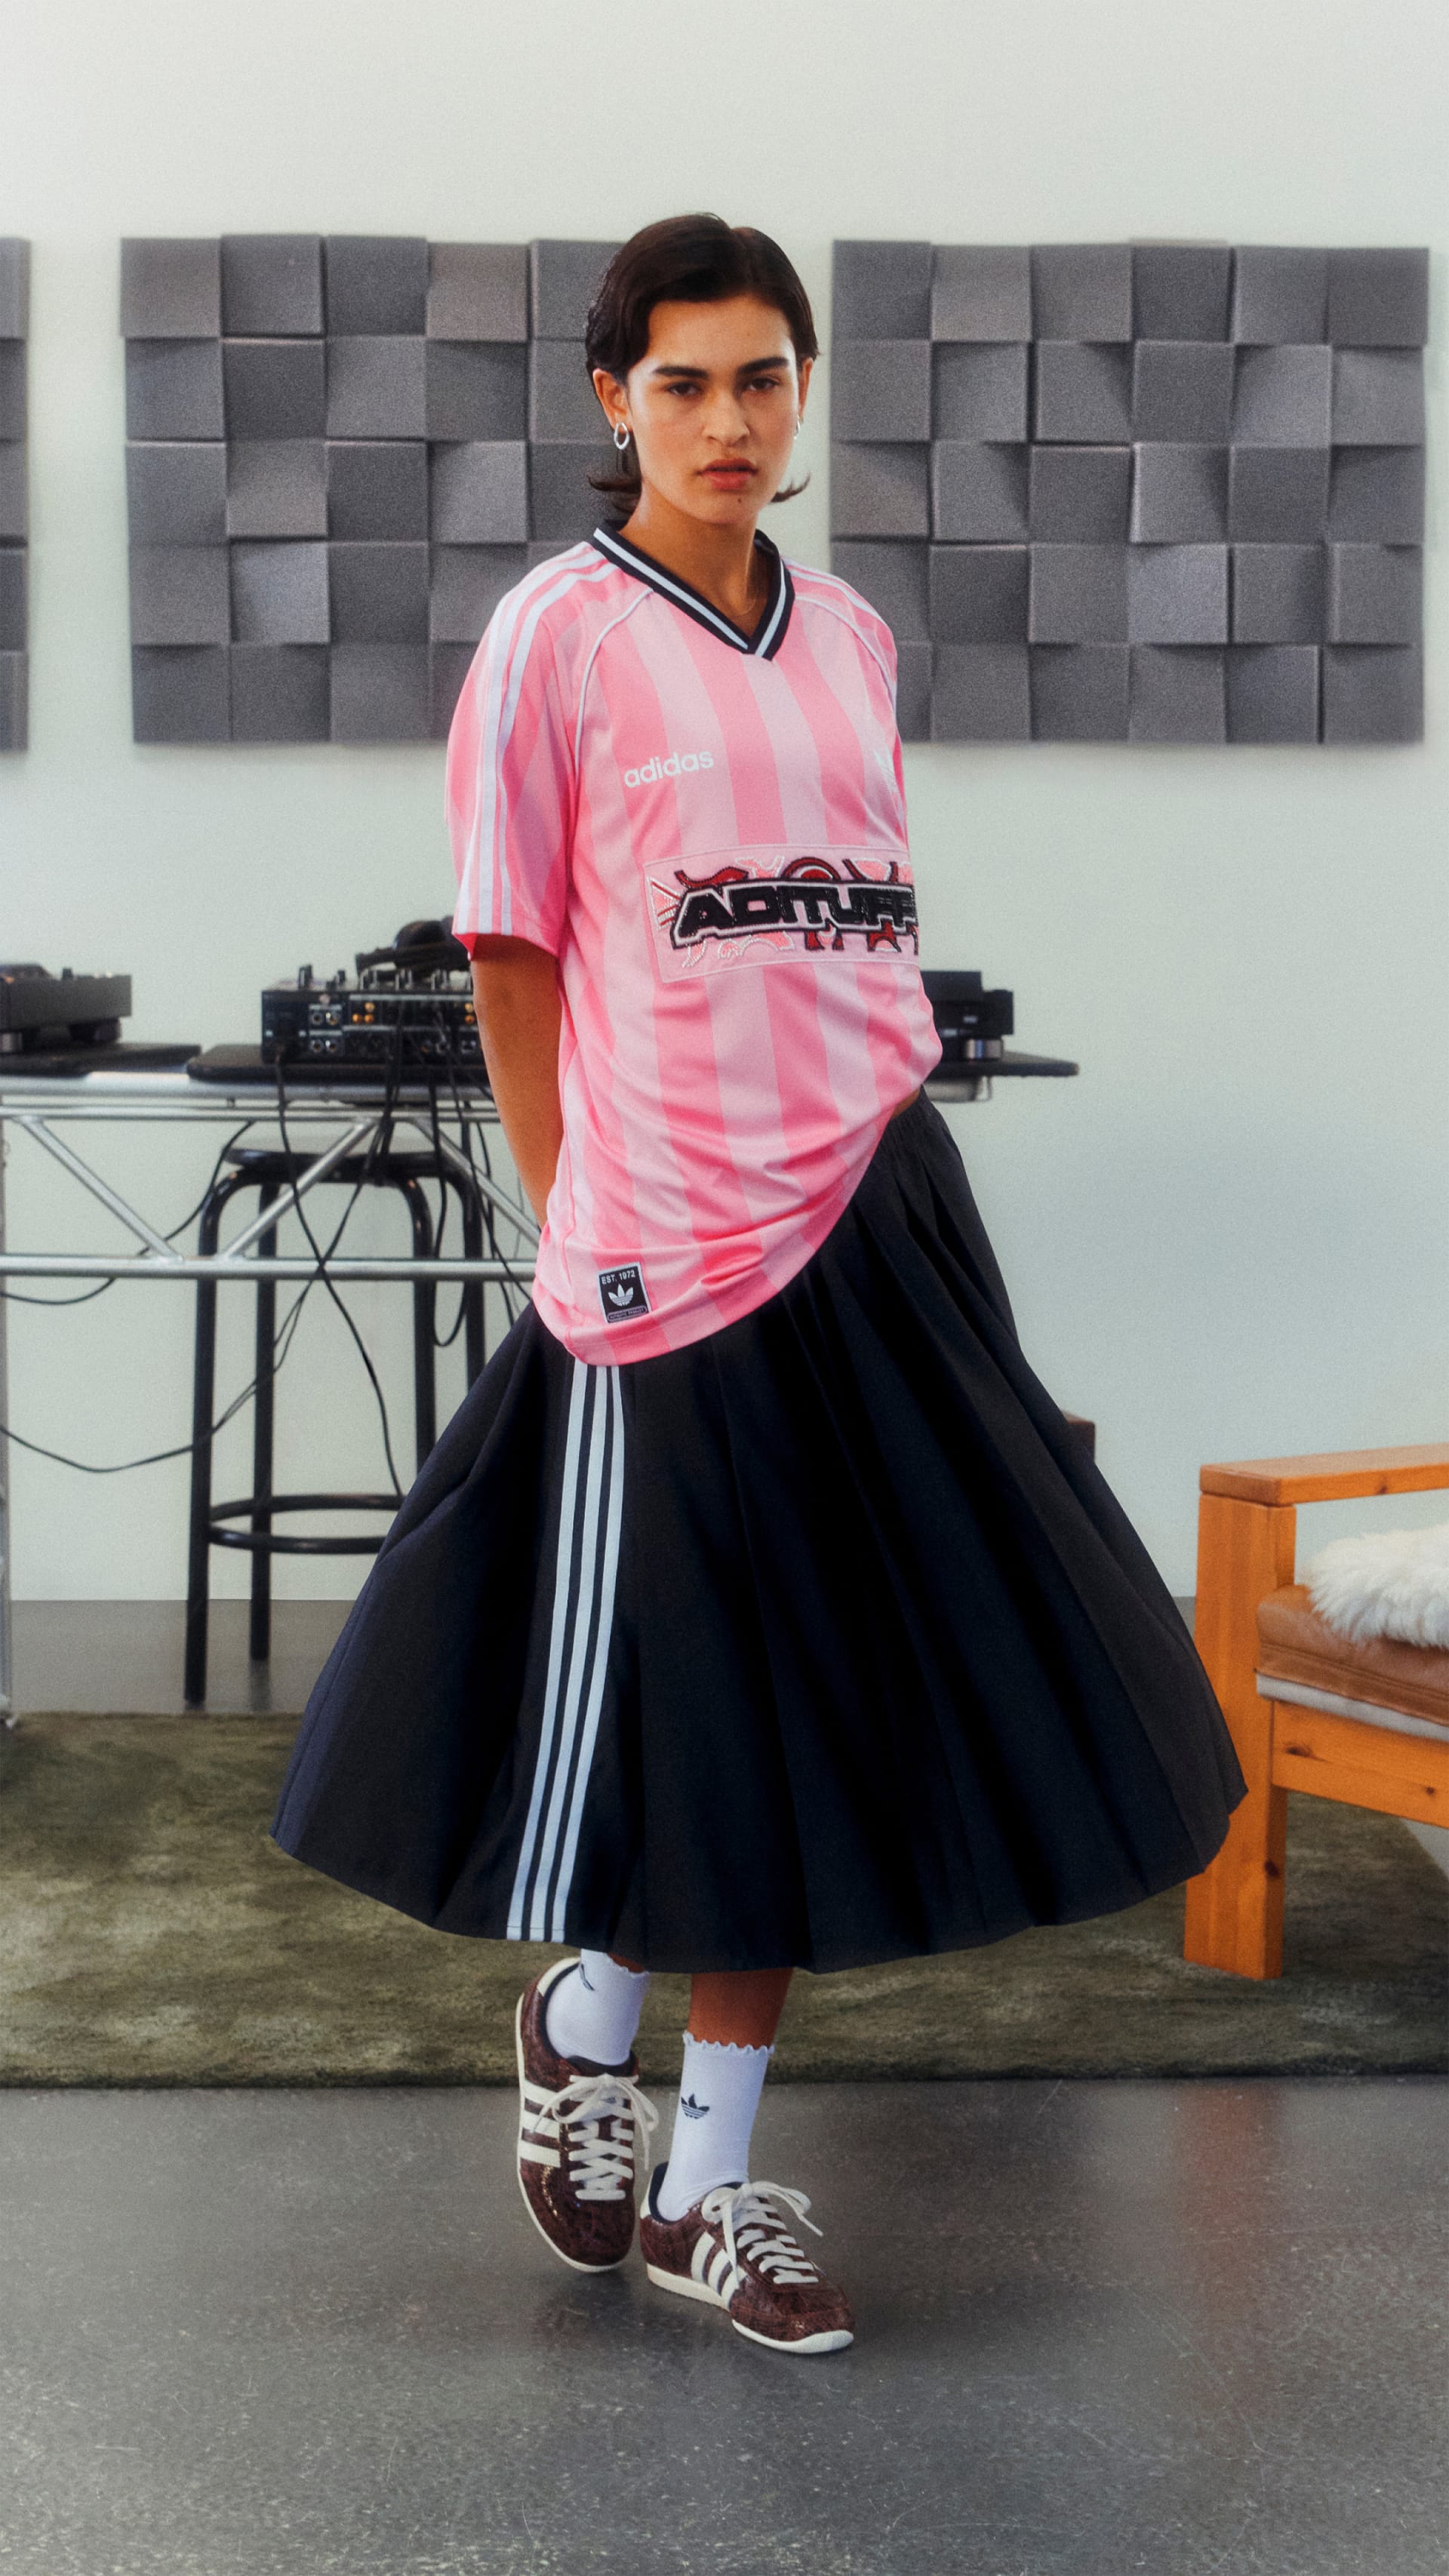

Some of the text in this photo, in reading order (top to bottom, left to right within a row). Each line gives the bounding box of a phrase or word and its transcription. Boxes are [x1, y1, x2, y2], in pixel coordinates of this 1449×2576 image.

[624, 751, 714, 788] adidas
[601, 1270, 636, 1285] EST. 1972
